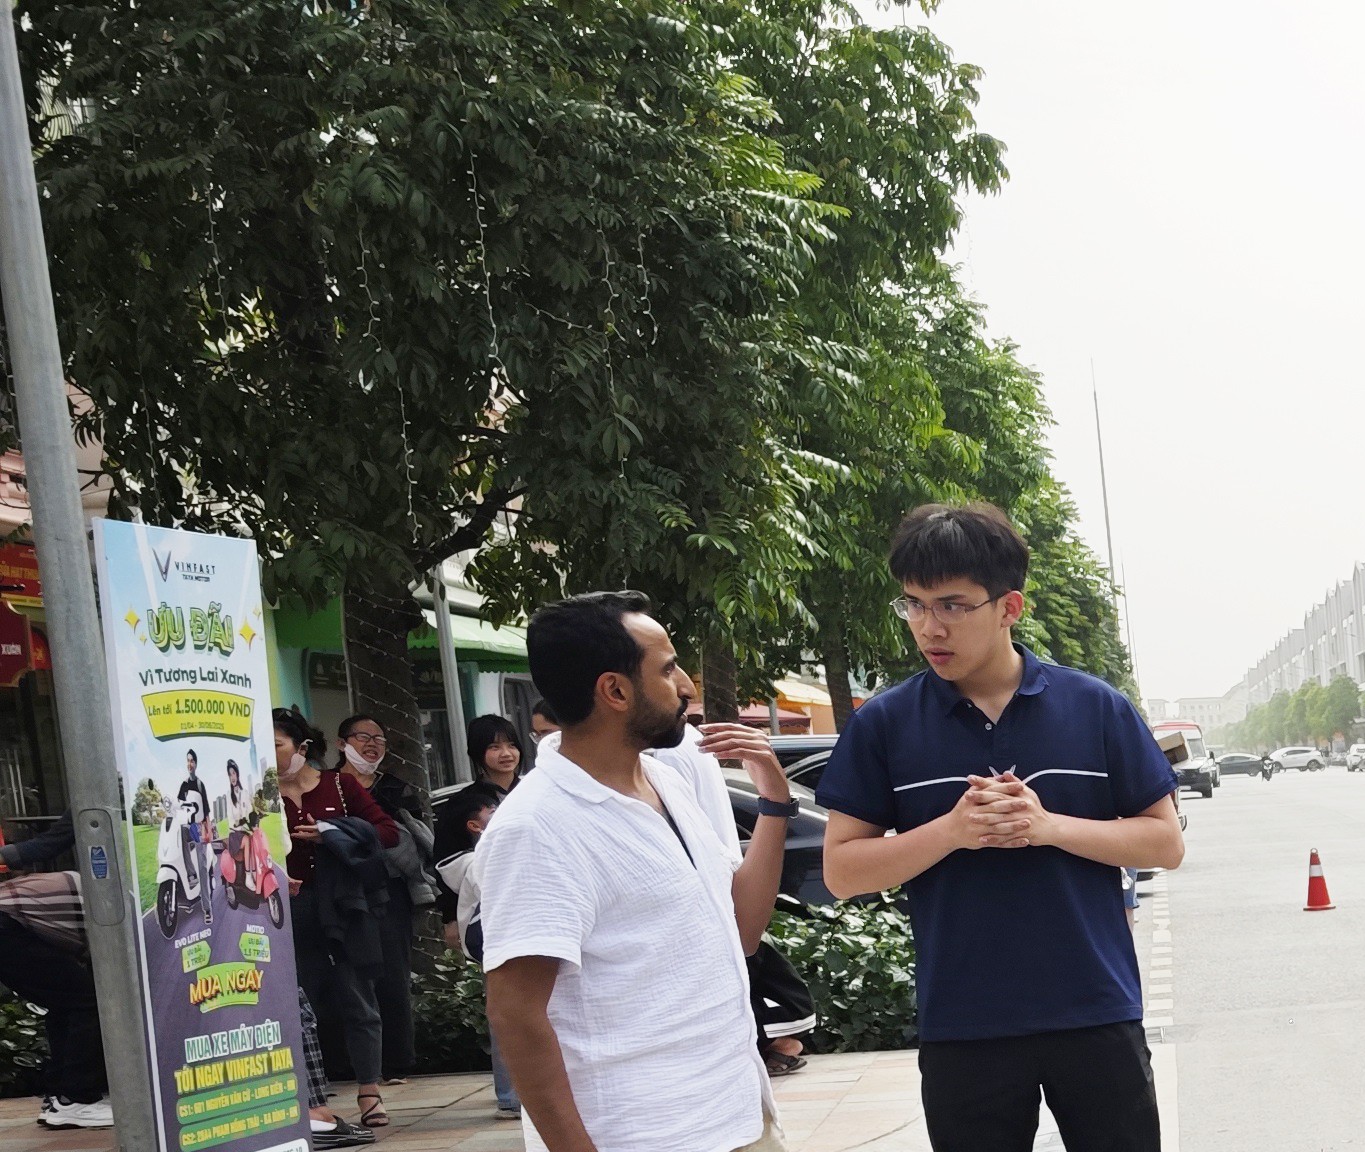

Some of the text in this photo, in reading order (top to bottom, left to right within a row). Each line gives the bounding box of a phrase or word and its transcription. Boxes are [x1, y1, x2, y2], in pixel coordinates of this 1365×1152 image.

[174, 561, 215, 574] VINFAST
[147, 601, 234, 657] ƯU ĐÃI
[139, 666, 252, 689] Vì Tương Lai Xanh
[148, 706, 161, 716] Lên
[175, 699, 225, 715] 1.500.000
[174, 938, 187, 949] EVO
[187, 933, 199, 945] LITE
[189, 970, 264, 1005] MUA NGAY
[184, 1035, 213, 1063] MUA
[211, 1031, 230, 1057] XE
[255, 1019, 281, 1050] ĐIỆN
[195, 1062, 224, 1089] NGAY
[226, 1053, 268, 1081] VINFAST
[269, 1046, 294, 1071] TAYA
